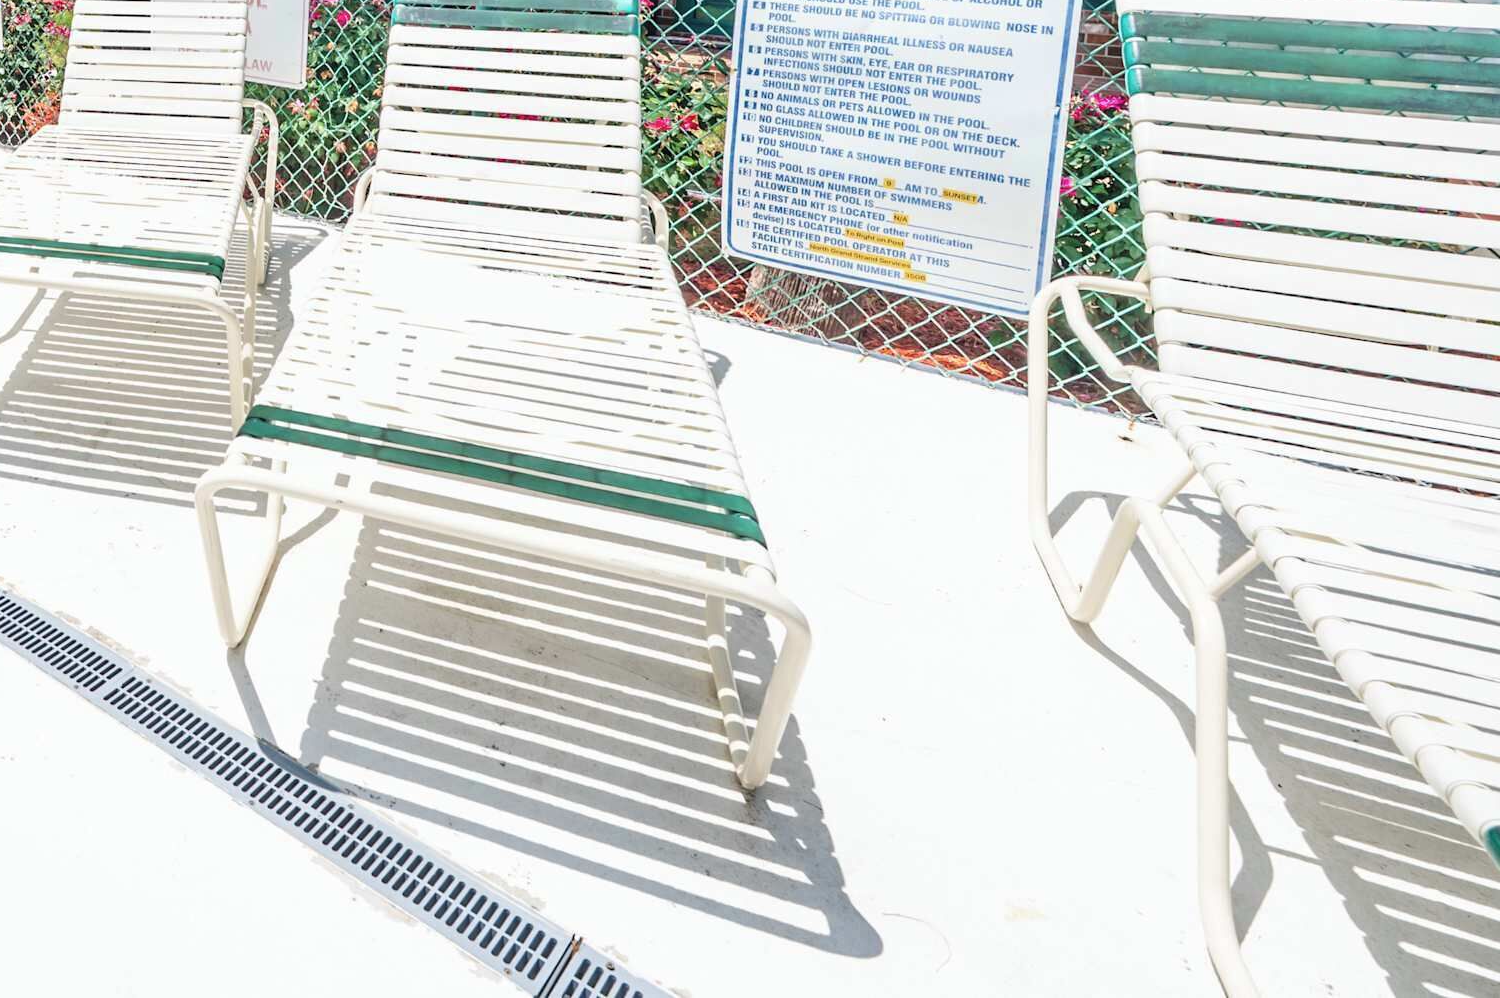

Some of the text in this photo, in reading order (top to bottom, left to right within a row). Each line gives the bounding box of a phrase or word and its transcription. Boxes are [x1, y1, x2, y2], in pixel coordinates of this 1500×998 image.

[769, 1, 800, 12] THERE
[802, 4, 842, 16] SHOULD
[844, 7, 858, 18] BE
[860, 9, 876, 19] NO
[878, 10, 926, 24] SPITTING
[928, 15, 945, 25] OR
[947, 17, 1000, 30] BLOWING
[1006, 21, 1038, 34] NOSE
[1040, 25, 1054, 35] IN
[766, 23, 812, 36] PERSONS
[813, 28, 839, 40] WITH
[841, 31, 900, 46] DIARRHEAL
[902, 37, 946, 50] ILLNESS
[948, 42, 964, 52] OR
[967, 43, 1013, 57] NAUSEA
[763, 57, 820, 71] INFECTIONS
[822, 63, 863, 76] SHOULD
[865, 68, 886, 79] NOT
[888, 70, 923, 83] ENTER
[926, 75, 946, 86] THE
[764, 46, 809, 59] PERSONS
[811, 51, 837, 62] WITH
[893, 60, 915, 71] EAR
[917, 63, 933, 73] OR
[935, 65, 1014, 82] RESPIRATORY
[761, 78, 800, 91] SHOULD
[802, 83, 822, 94] NOT
[824, 86, 856, 98] ENTER
[858, 90, 878, 102] THE
[762, 68, 807, 82] PERSONS
[809, 73, 835, 85] WITH
[837, 77, 865, 89] OPEN
[867, 81, 911, 95] LESIONS
[913, 87, 929, 97] OR
[931, 89, 981, 104] WOUNDS
[759, 102, 773, 112] NO
[775, 104, 806, 116] GLASS
[807, 109, 855, 123] ALLOWED
[856, 115, 868, 125] IN
[871, 117, 891, 128] THE
[893, 121, 921, 133] POOL
[923, 125, 939, 136] OR
[942, 128, 958, 139] ON
[961, 130, 983, 142] THE
[760, 90, 774, 100] NO
[776, 92, 820, 106] ANIMALS
[821, 98, 836, 108] OR
[838, 100, 864, 112] PETS
[866, 104, 916, 119] ALLOWED
[918, 112, 930, 122] IN
[933, 113, 954, 125] THE
[758, 113, 772, 124] NO
[774, 116, 822, 131] CHILDREN
[824, 123, 865, 137] SHOULD
[867, 129, 881, 140] BE
[883, 132, 895, 142] IN
[898, 134, 918, 146] THE
[920, 137, 949, 151] POOL
[952, 142, 1005, 158] WITHOUT
[755, 157, 777, 169] THIS
[778, 161, 803, 174] POOL
[806, 166, 816, 176] IS
[817, 168, 845, 181] OPEN
[847, 173, 878, 186] FROM
[904, 183, 922, 194] AM
[923, 186, 938, 196] TO
[757, 136, 777, 147] YOU
[778, 139, 817, 153] SHOULD
[819, 145, 844, 157] TAKE
[846, 150, 853, 159] A
[856, 151, 901, 167] SHOWER
[903, 159, 946, 174] BEFORE
[948, 166, 1005, 184] ENTERING
[1008, 175, 1030, 188] THE
[753, 179, 798, 194] ALLOWED
[800, 187, 811, 196] IN
[813, 189, 832, 200] THE
[834, 193, 861, 206] POOL
[864, 198, 874, 208] IS
[753, 190, 761, 199] A
[762, 191, 789, 203] FIRST
[790, 197, 807, 207] AID
[809, 200, 825, 210] KIT
[827, 204, 837, 213] IS
[839, 206, 886, 222] LOCATED
[754, 169, 772, 180] THE
[774, 172, 825, 189] MAXIMUM
[827, 181, 871, 197] NUMBER
[873, 190, 887, 199] OF
[890, 192, 952, 211] SWIMMERS
[752, 201, 766, 211] AN
[768, 204, 827, 222] EMERGENCY
[829, 215, 863, 229] PHONE
[866, 222, 880, 232] (or
[882, 227, 909, 238] other
[912, 233, 973, 250] notification
